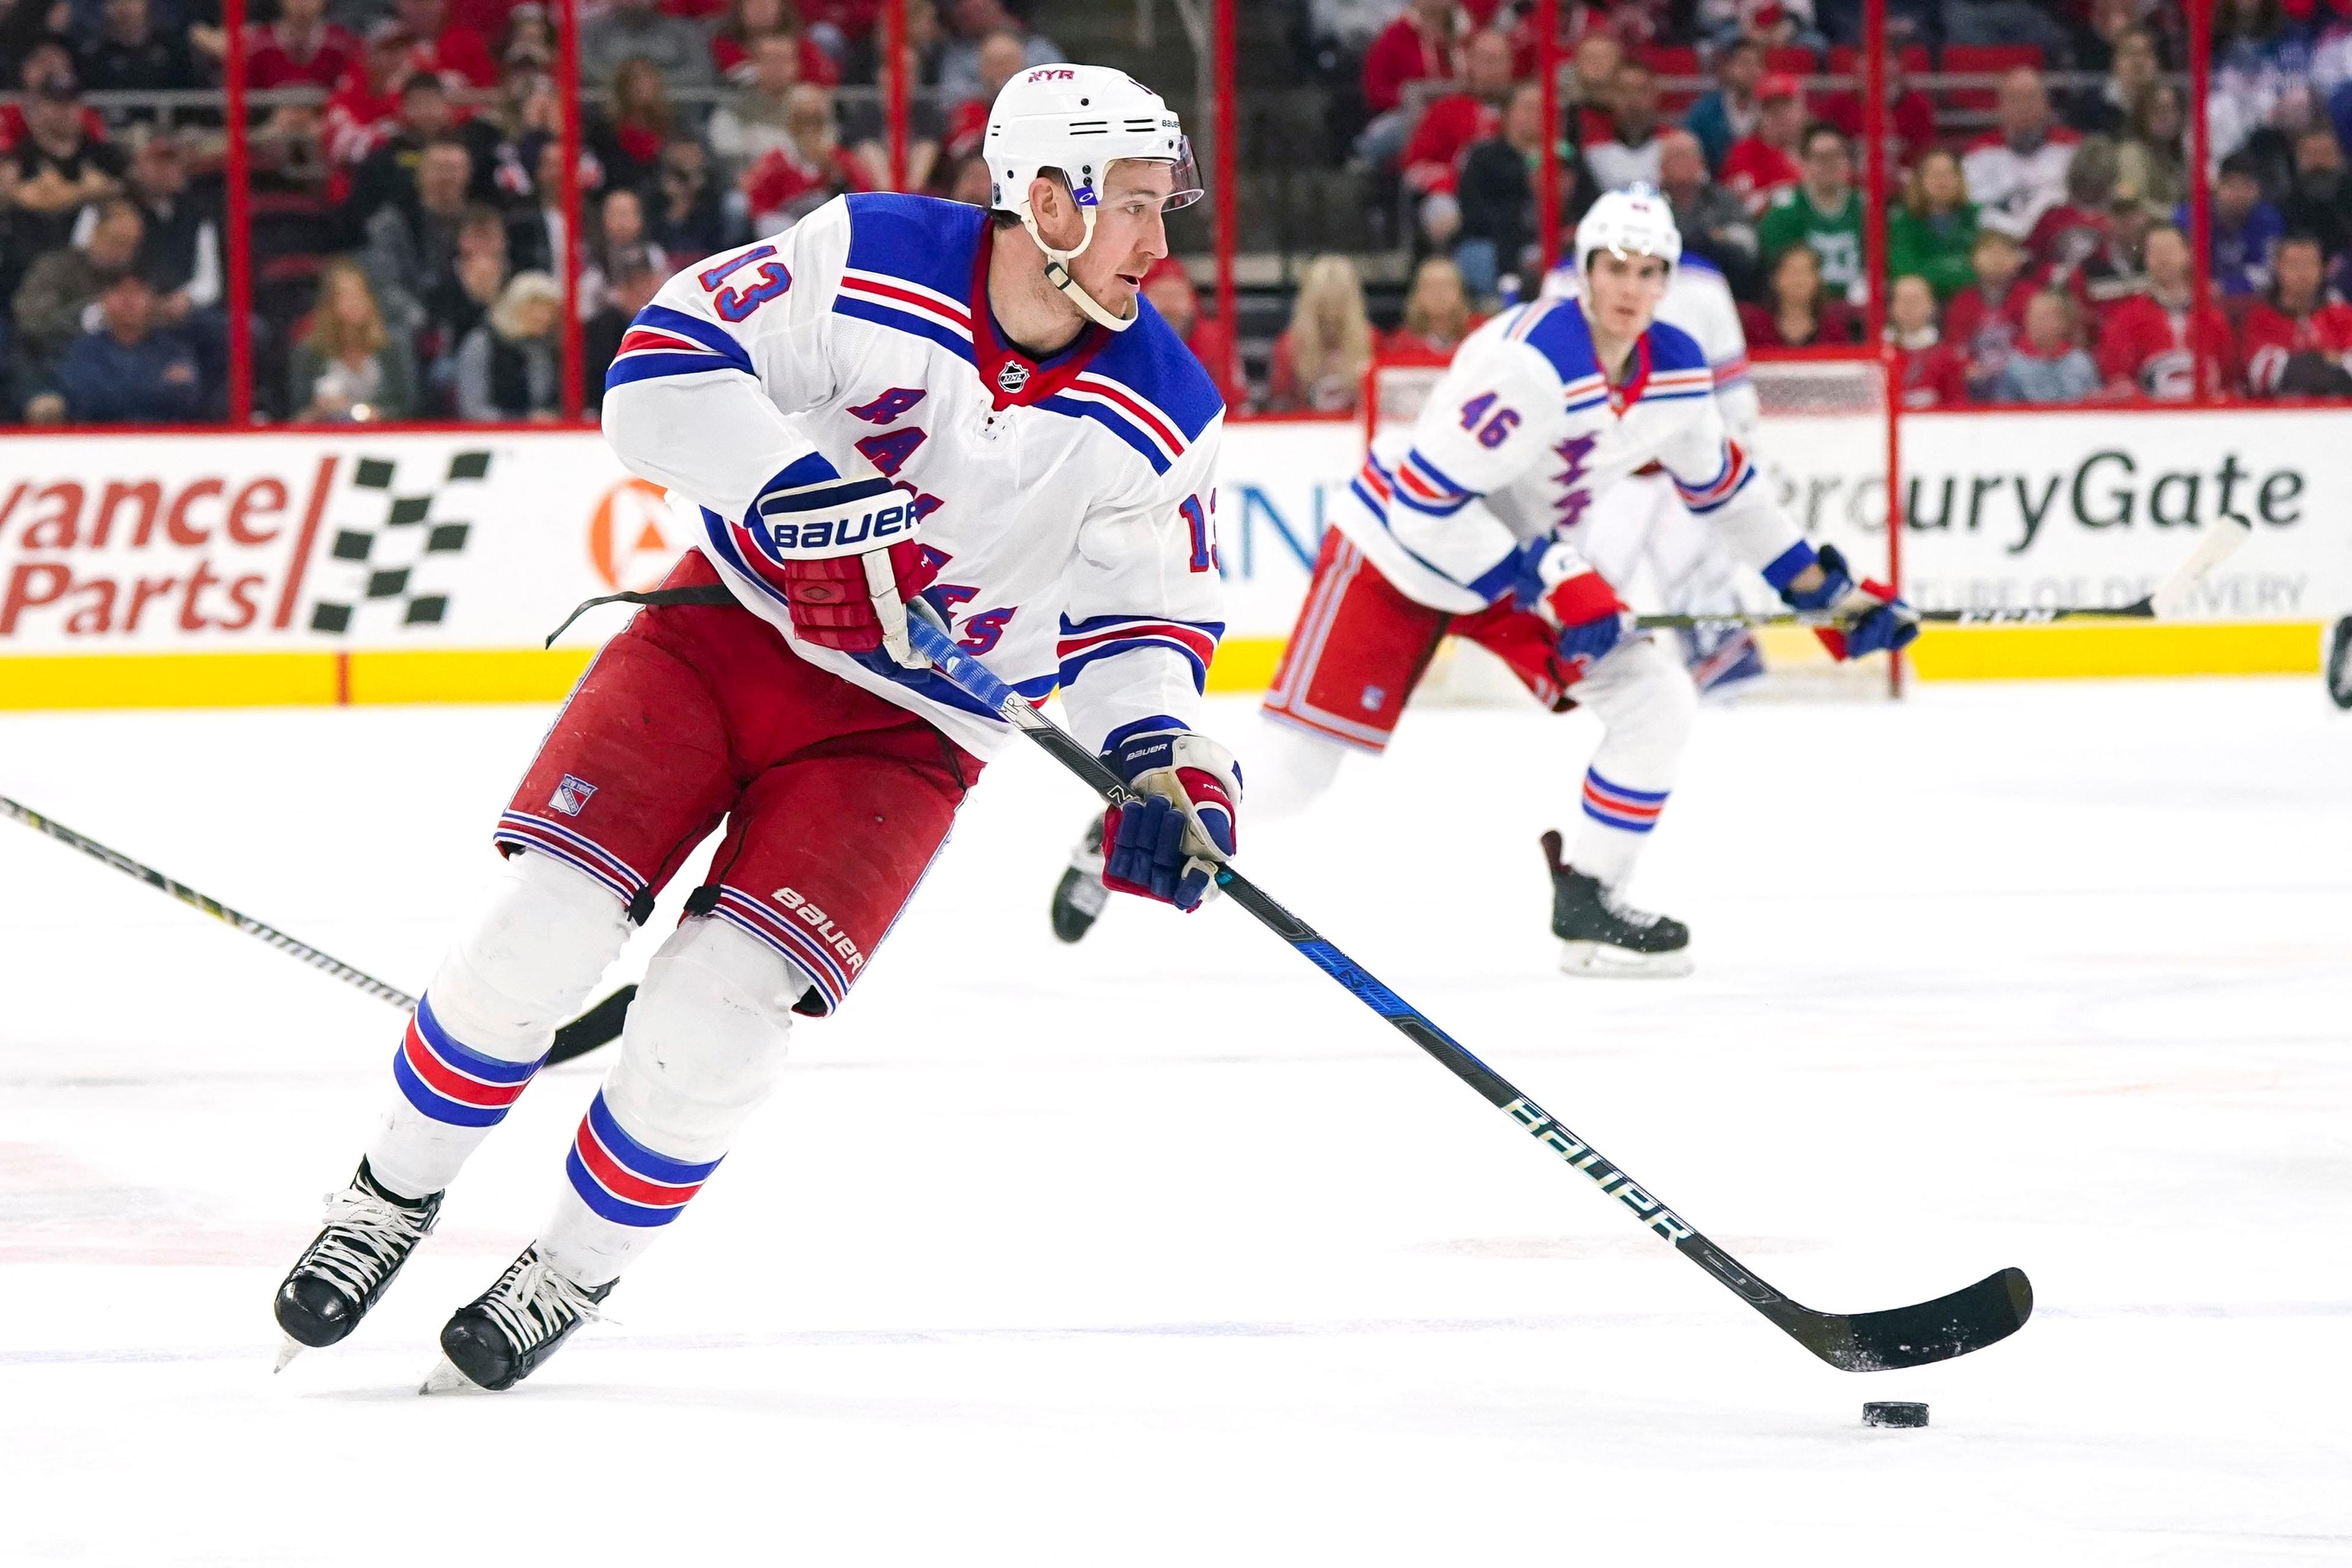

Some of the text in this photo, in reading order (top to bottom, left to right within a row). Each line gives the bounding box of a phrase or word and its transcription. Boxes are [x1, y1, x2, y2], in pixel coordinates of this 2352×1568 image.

[698, 245, 793, 323] 13
[1461, 392, 1521, 448] 46
[0, 559, 265, 634] Parts
[1125, 743, 1168, 762] BAUER
[771, 887, 863, 974] BAUER
